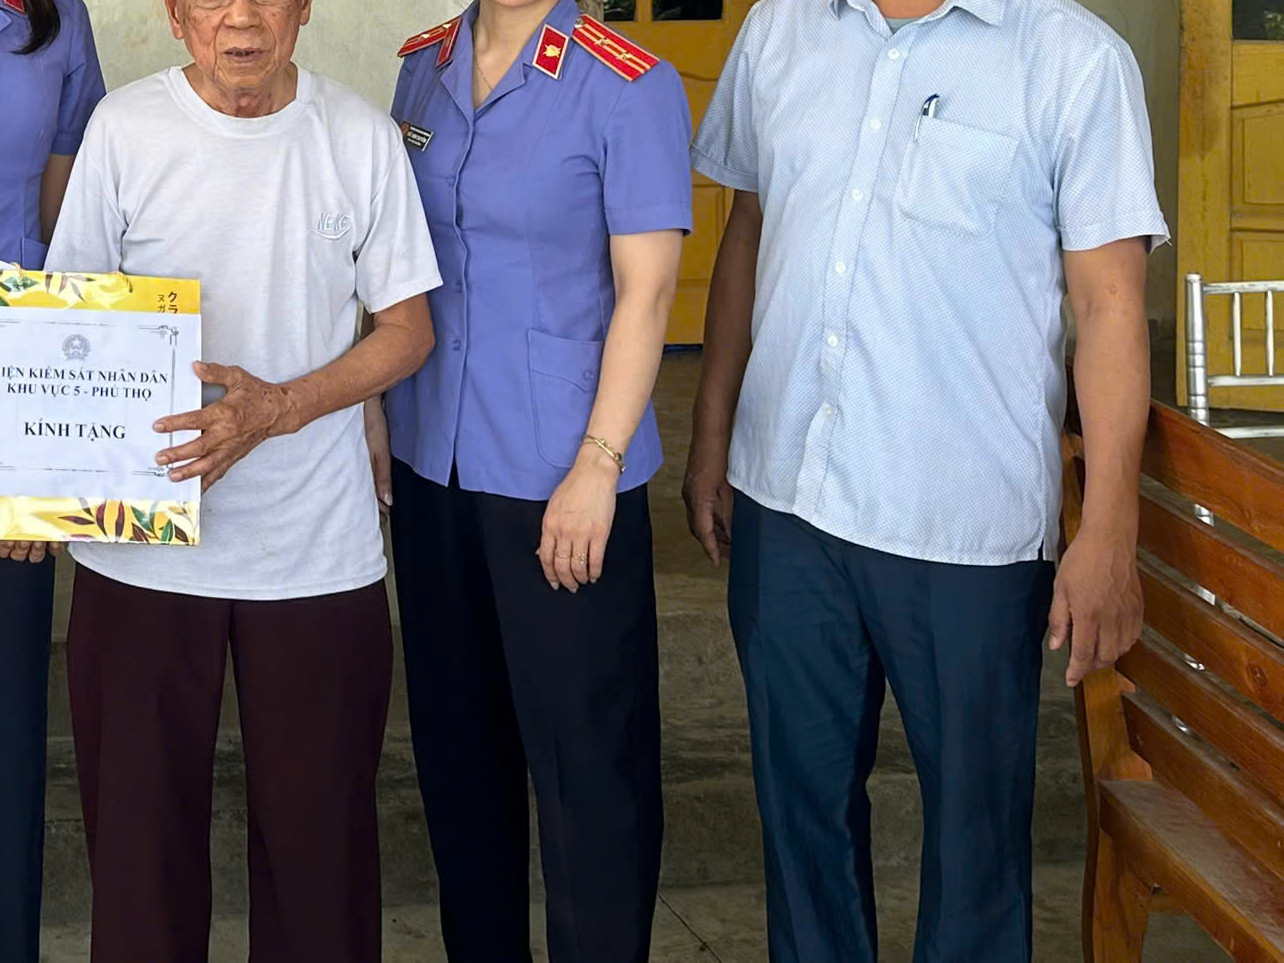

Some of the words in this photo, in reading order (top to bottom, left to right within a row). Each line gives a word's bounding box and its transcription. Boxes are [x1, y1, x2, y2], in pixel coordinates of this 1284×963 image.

[69, 366, 94, 381] SÁT
[98, 368, 136, 382] NHÂN
[140, 370, 168, 384] DÂN
[7, 383, 37, 395] KHU
[41, 384, 70, 397] VỰC
[73, 386, 81, 397] 5
[92, 385, 119, 398] PHÚ
[123, 387, 152, 402] THỌ
[24, 417, 69, 437] KÍNH
[76, 422, 126, 442] TẶNG
